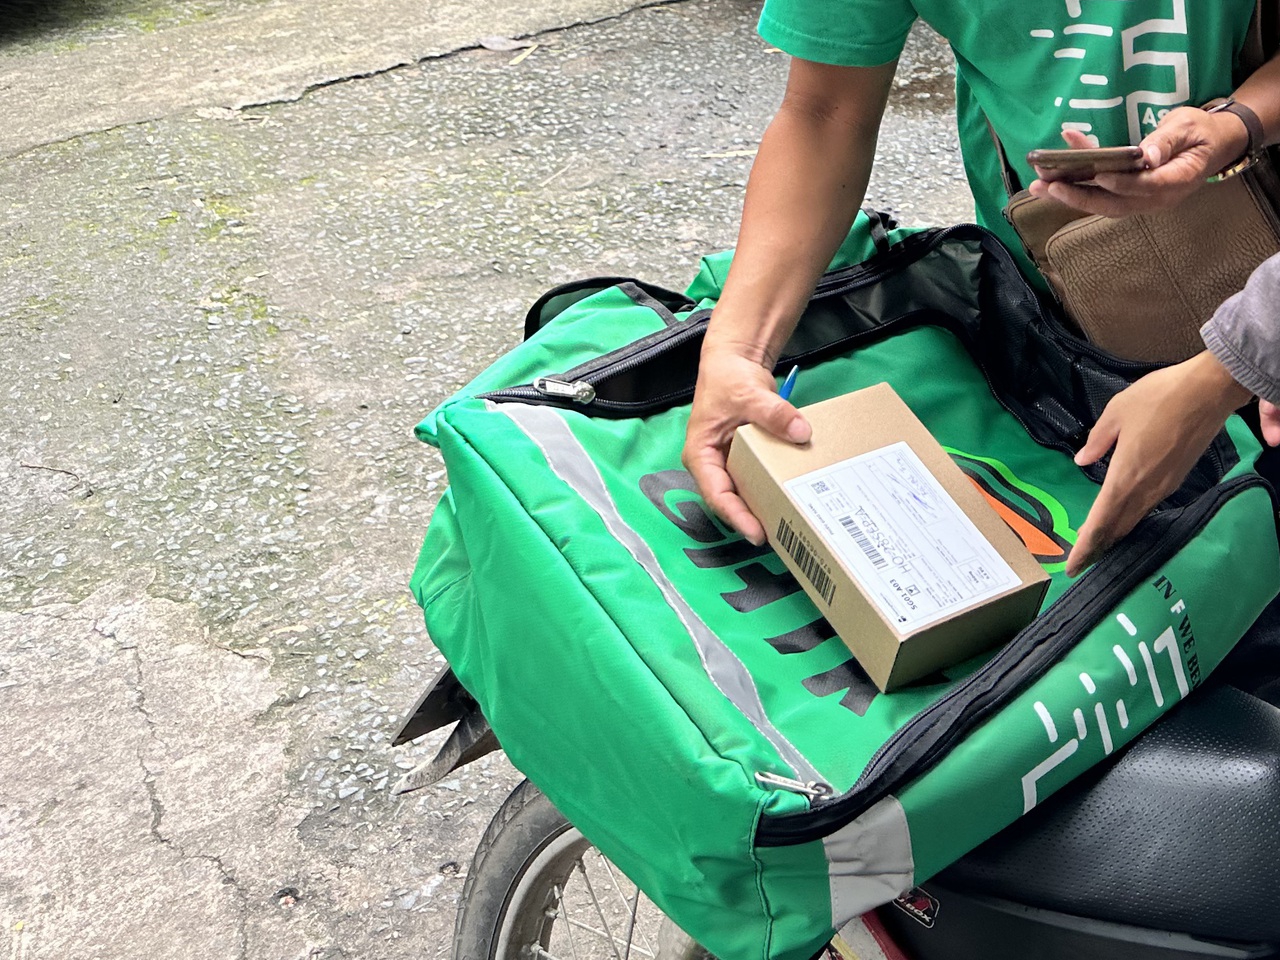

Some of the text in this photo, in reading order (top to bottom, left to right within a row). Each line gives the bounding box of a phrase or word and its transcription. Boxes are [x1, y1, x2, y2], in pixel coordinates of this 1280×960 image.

[1152, 575, 1177, 600] IN
[1170, 599, 1186, 614] F
[1178, 614, 1196, 654] WE
